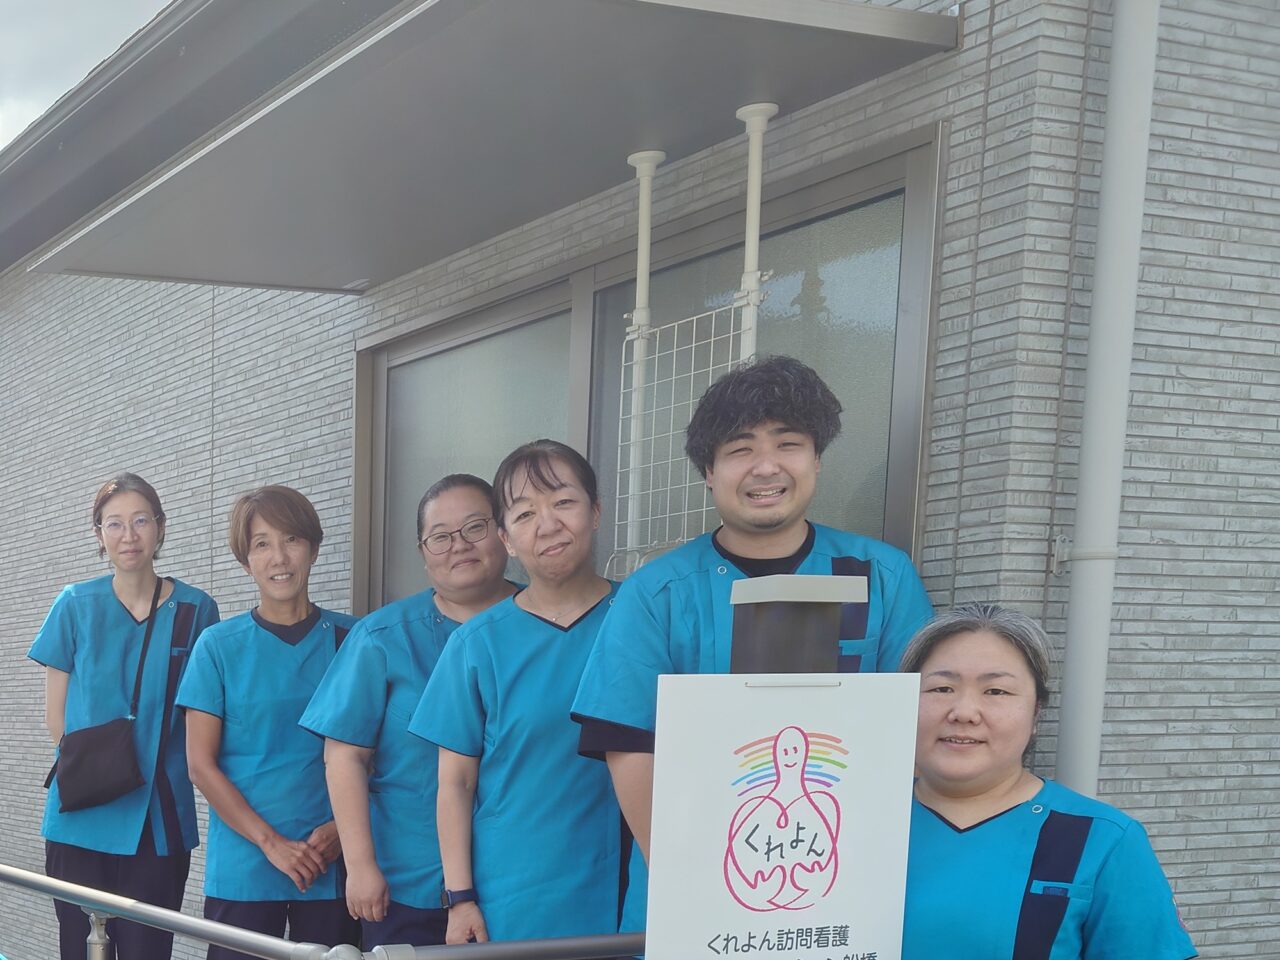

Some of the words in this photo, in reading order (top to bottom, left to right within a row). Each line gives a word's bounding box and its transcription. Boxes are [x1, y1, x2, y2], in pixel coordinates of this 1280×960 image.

[744, 821, 826, 862] くれよん
[706, 924, 851, 955] くれよん訪問看護
